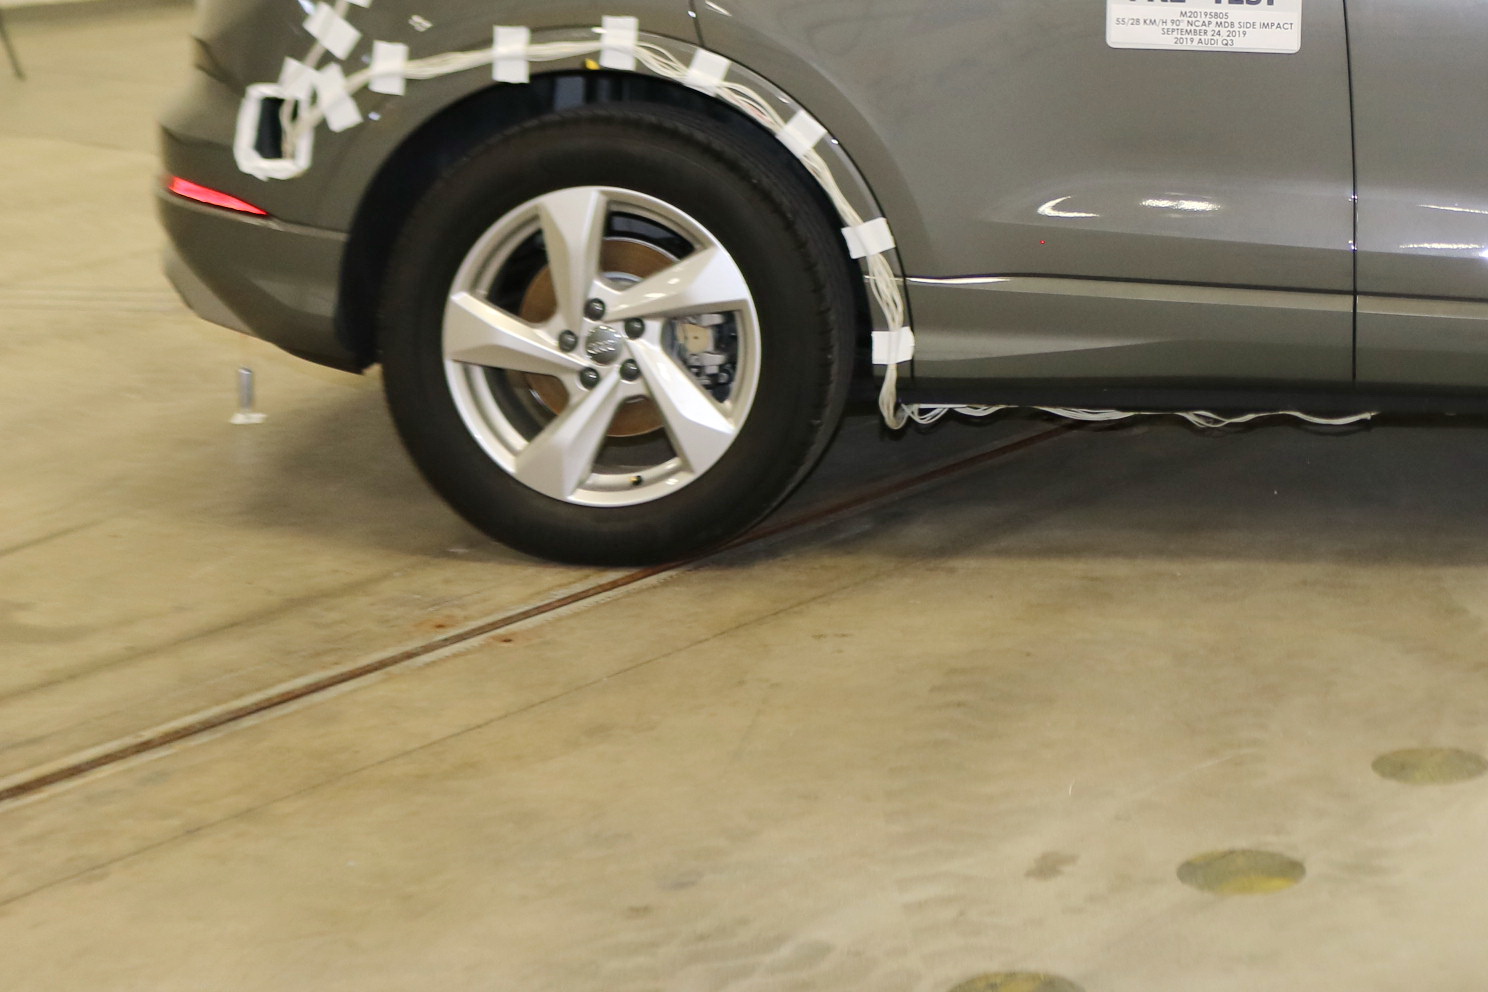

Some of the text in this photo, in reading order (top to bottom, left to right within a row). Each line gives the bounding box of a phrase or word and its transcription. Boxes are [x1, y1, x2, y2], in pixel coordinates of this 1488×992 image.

[1179, 10, 1229, 20] M20195805
[1115, 17, 1141, 27] 55/28
[1143, 18, 1168, 28] KM/H
[1186, 19, 1213, 28] NCAP
[1214, 20, 1236, 29] MDB
[1237, 21, 1257, 30] SIDE
[1259, 21, 1294, 31] IMPACT
[1161, 27, 1209, 37] SEPTEMBER
[1226, 30, 1248, 39] 2019
[1173, 36, 1235, 47] 2019 AUDI Q3
